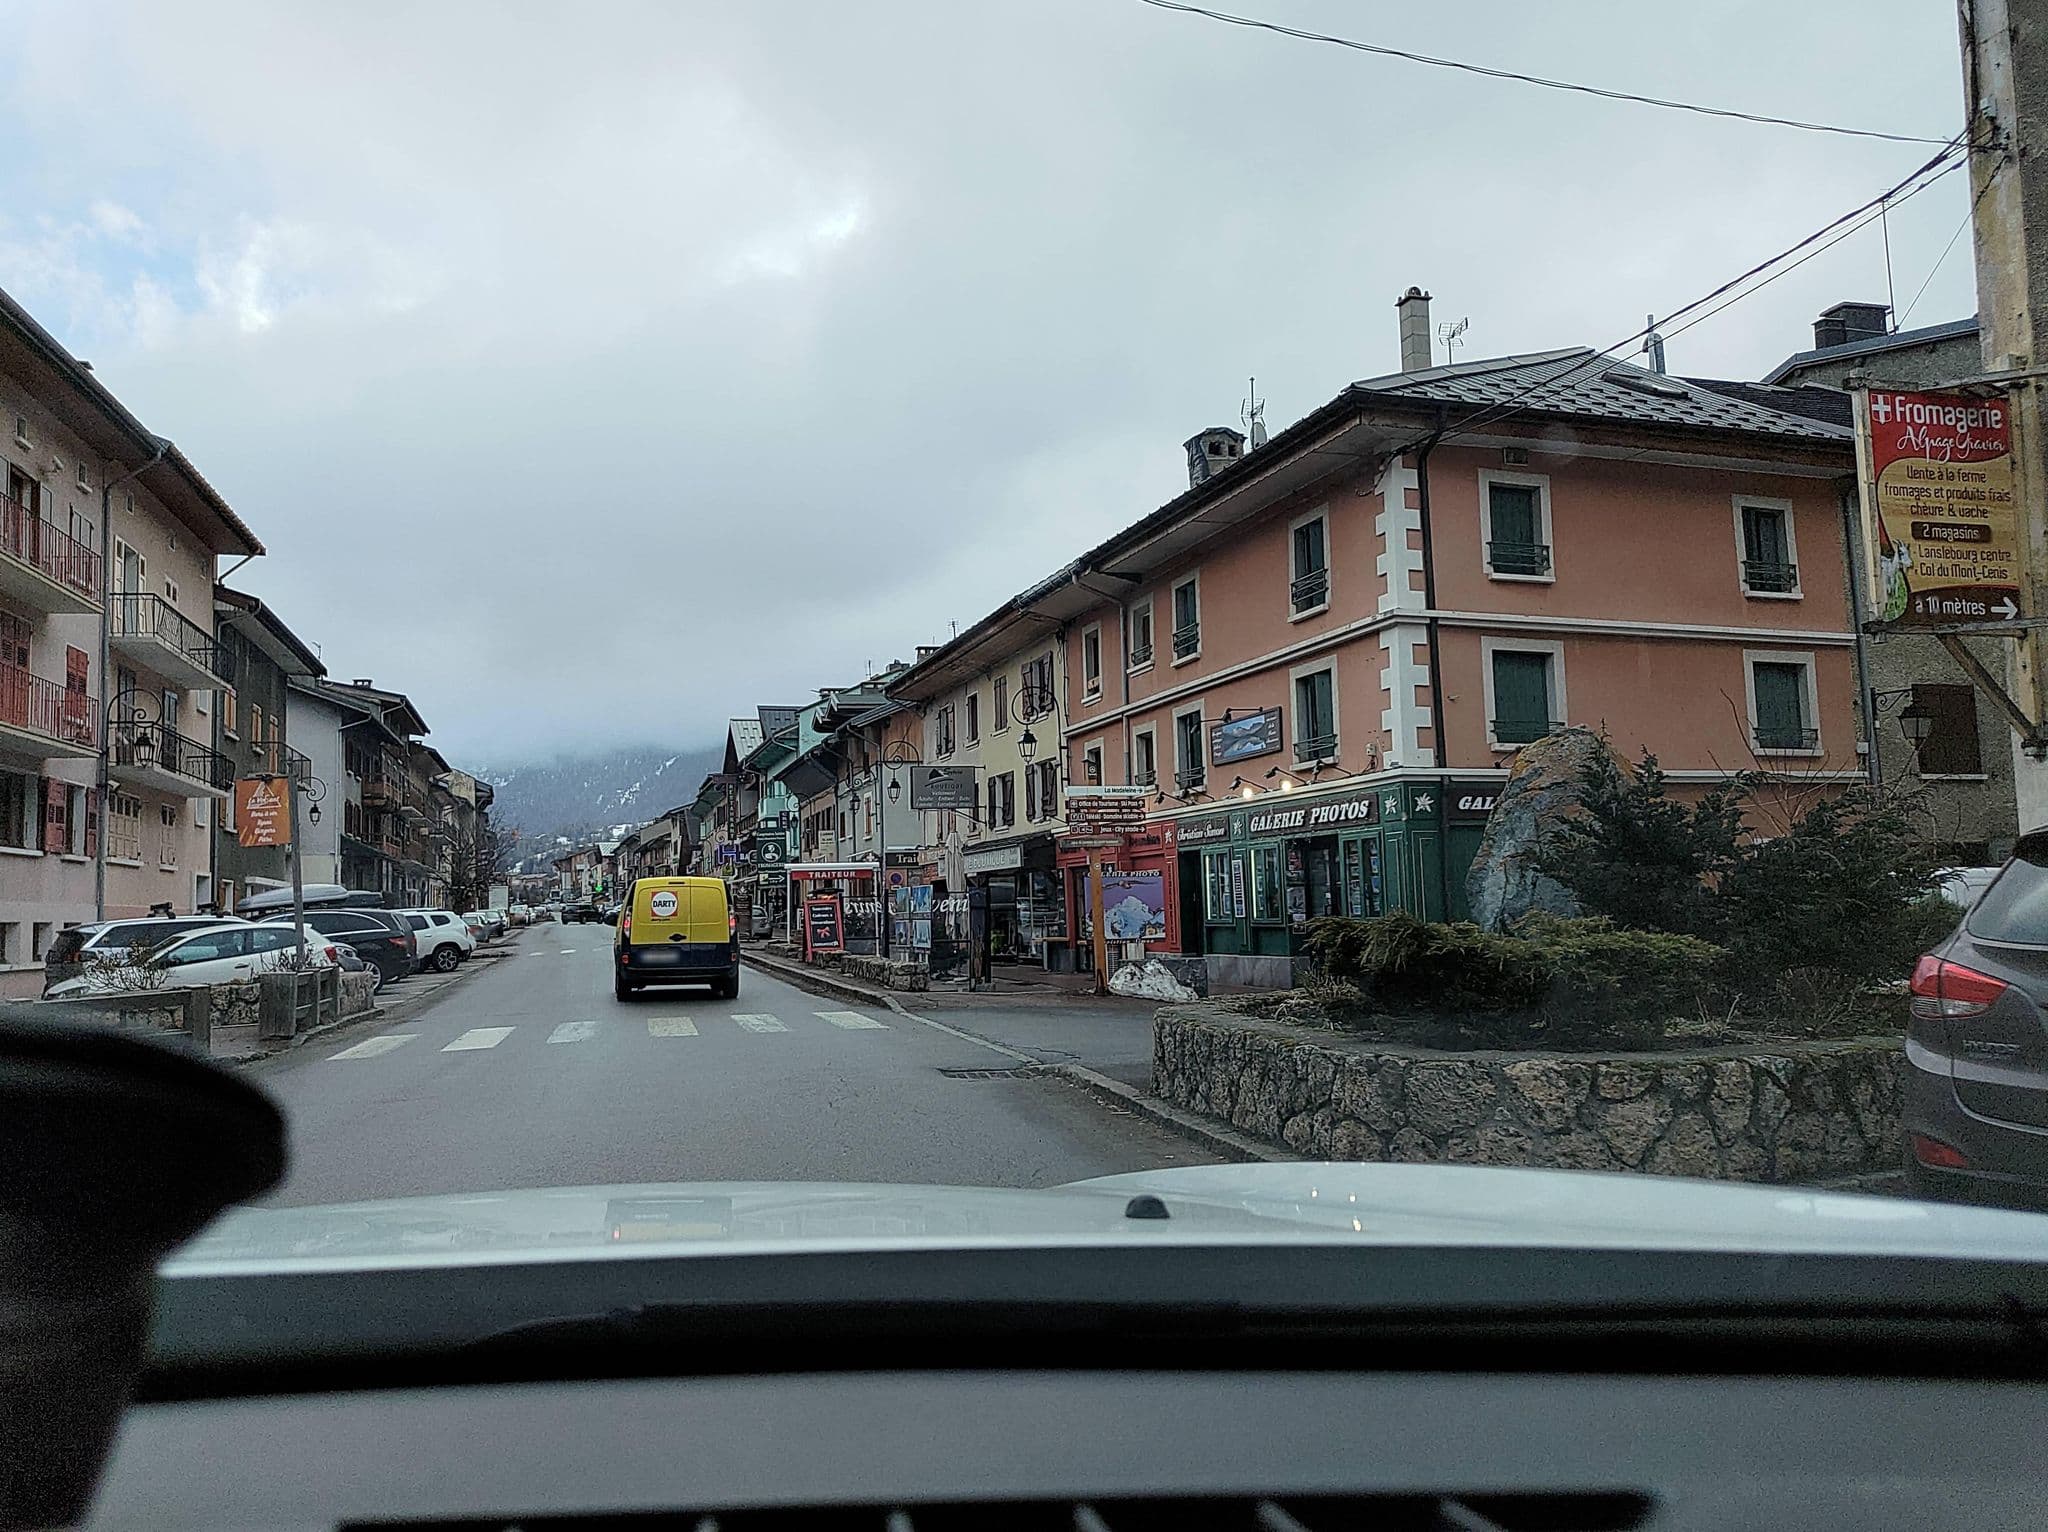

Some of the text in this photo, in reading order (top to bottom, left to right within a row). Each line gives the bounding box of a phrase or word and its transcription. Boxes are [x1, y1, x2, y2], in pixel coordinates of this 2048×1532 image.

[1895, 395, 2003, 433] Fromagerie
[1897, 425, 1955, 463] Alpage
[1937, 467, 1944, 480] à
[1946, 467, 1955, 482] la
[1957, 469, 1987, 483] ferme
[1884, 482, 2011, 502] fromages et produits frais
[1947, 504, 1956, 517] &
[1958, 505, 1988, 518] vache
[1923, 524, 1979, 542] 2 magasins
[1918, 545, 2011, 563] Lanslebourg centre
[1920, 562, 2009, 579] Col du Mont-Cenis
[1926, 596, 1940, 614] 10
[1942, 598, 1986, 615] mètres
[1250, 800, 1369, 832] GALERIE PHOTOS
[1177, 828, 1203, 841] Christian
[1204, 823, 1225, 838] Simon
[808, 871, 856, 879] TRAITEUR
[653, 900, 676, 908] DARTY
